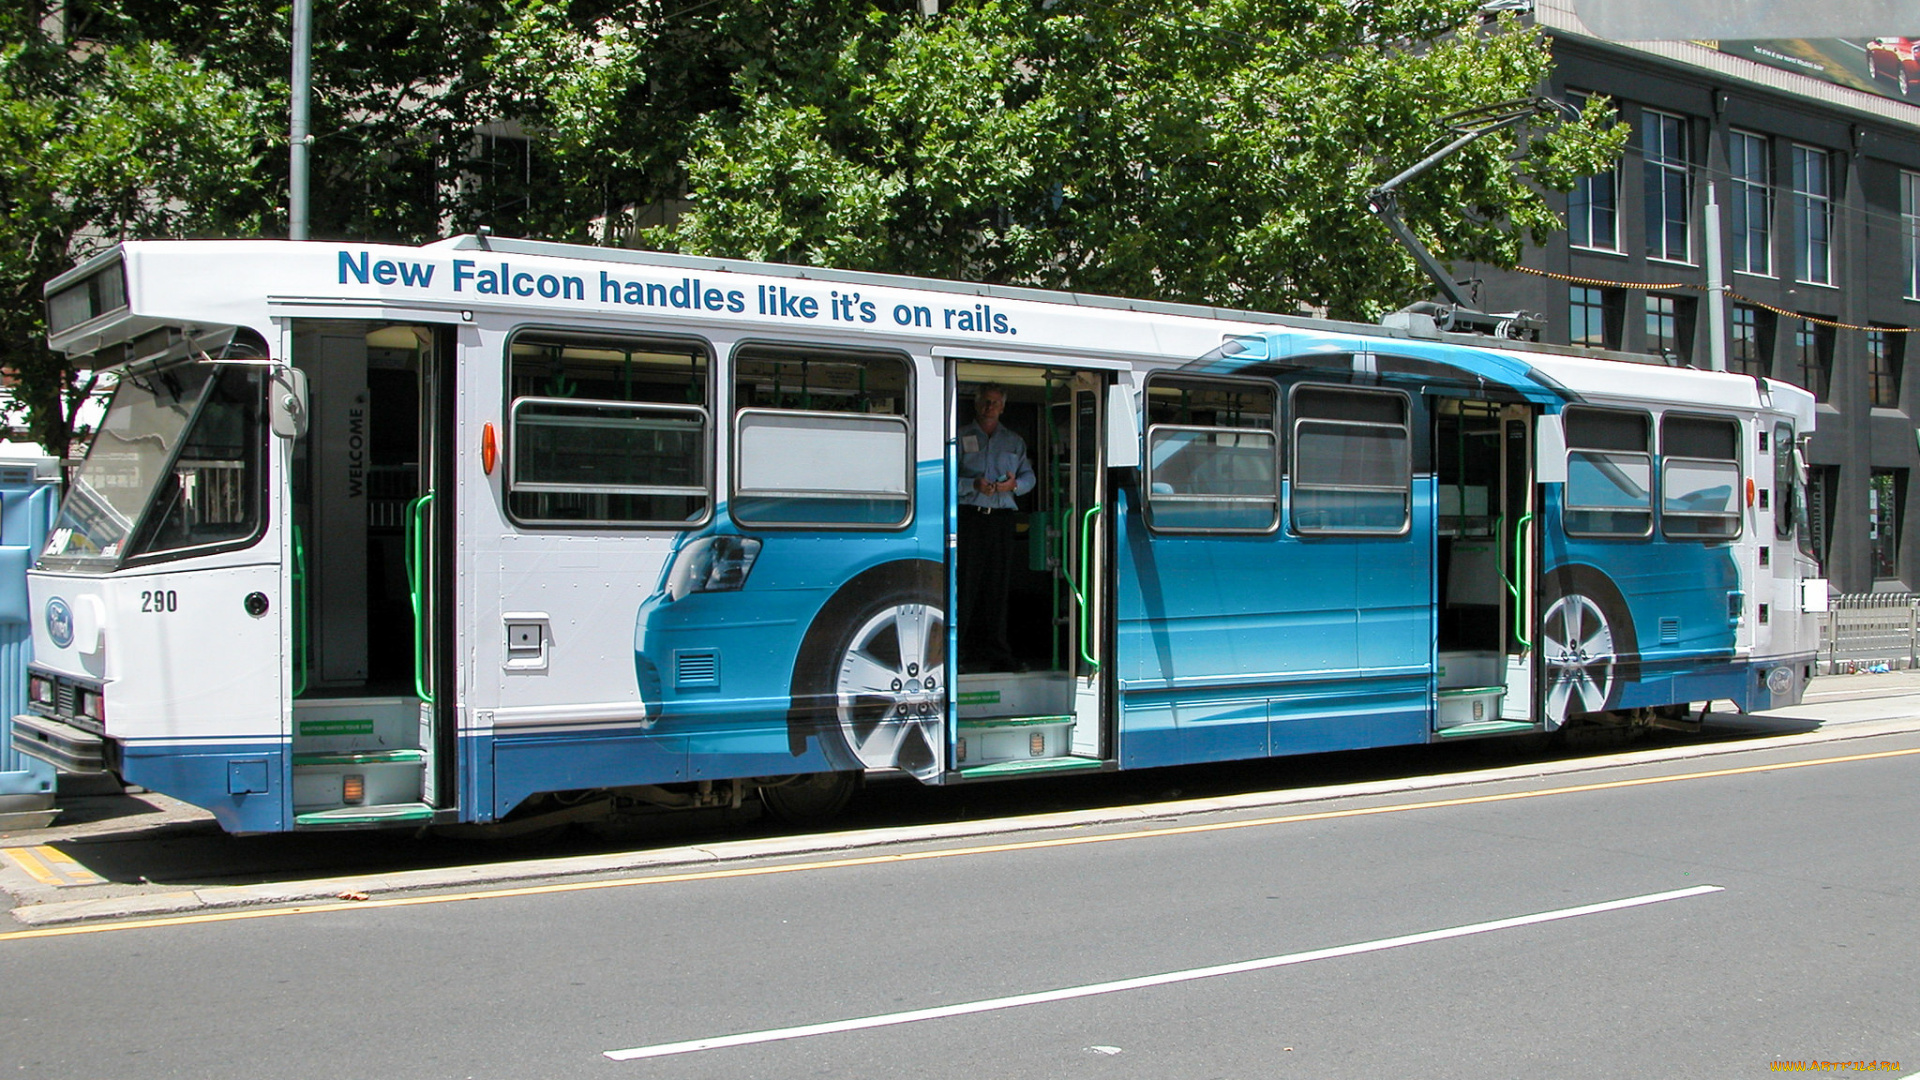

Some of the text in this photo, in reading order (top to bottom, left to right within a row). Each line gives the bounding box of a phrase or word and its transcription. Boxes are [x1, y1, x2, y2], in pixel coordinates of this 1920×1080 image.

[338, 251, 435, 288] New
[453, 259, 585, 300] Falcon
[600, 271, 745, 313] handles
[758, 285, 819, 319] like
[893, 305, 932, 328] on
[944, 304, 1017, 335] rails.
[349, 408, 363, 498] WELCOME
[1812, 480, 1822, 549] Furniture
[45, 528, 73, 555] 290
[141, 590, 177, 613] 290
[49, 603, 70, 640] Ford
[1772, 669, 1791, 691] Ford
